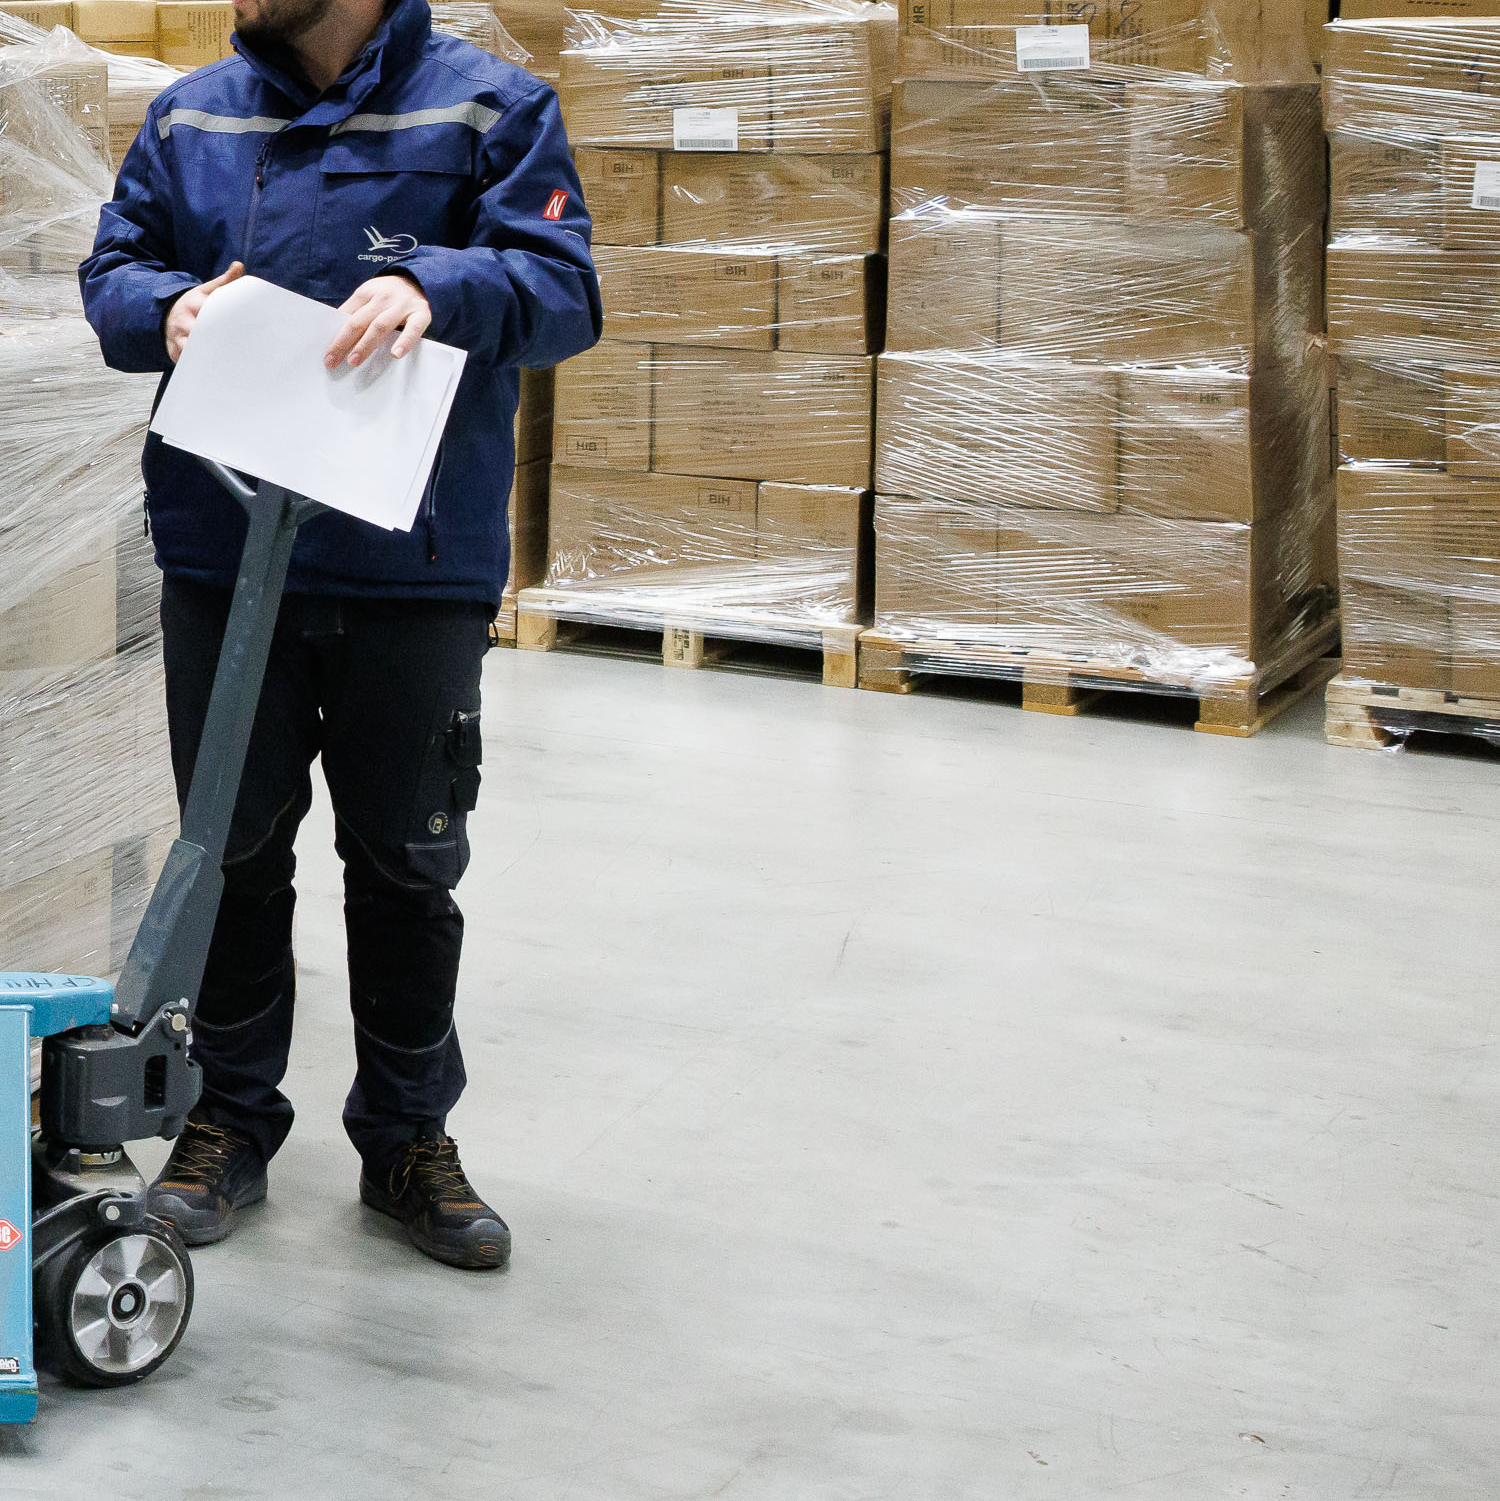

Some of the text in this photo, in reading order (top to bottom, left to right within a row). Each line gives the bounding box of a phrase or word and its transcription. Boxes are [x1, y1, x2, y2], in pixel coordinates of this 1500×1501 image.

[911, 3, 925, 26] HR
[546, 194, 565, 218] N
[357, 253, 399, 263] cargo-pa
